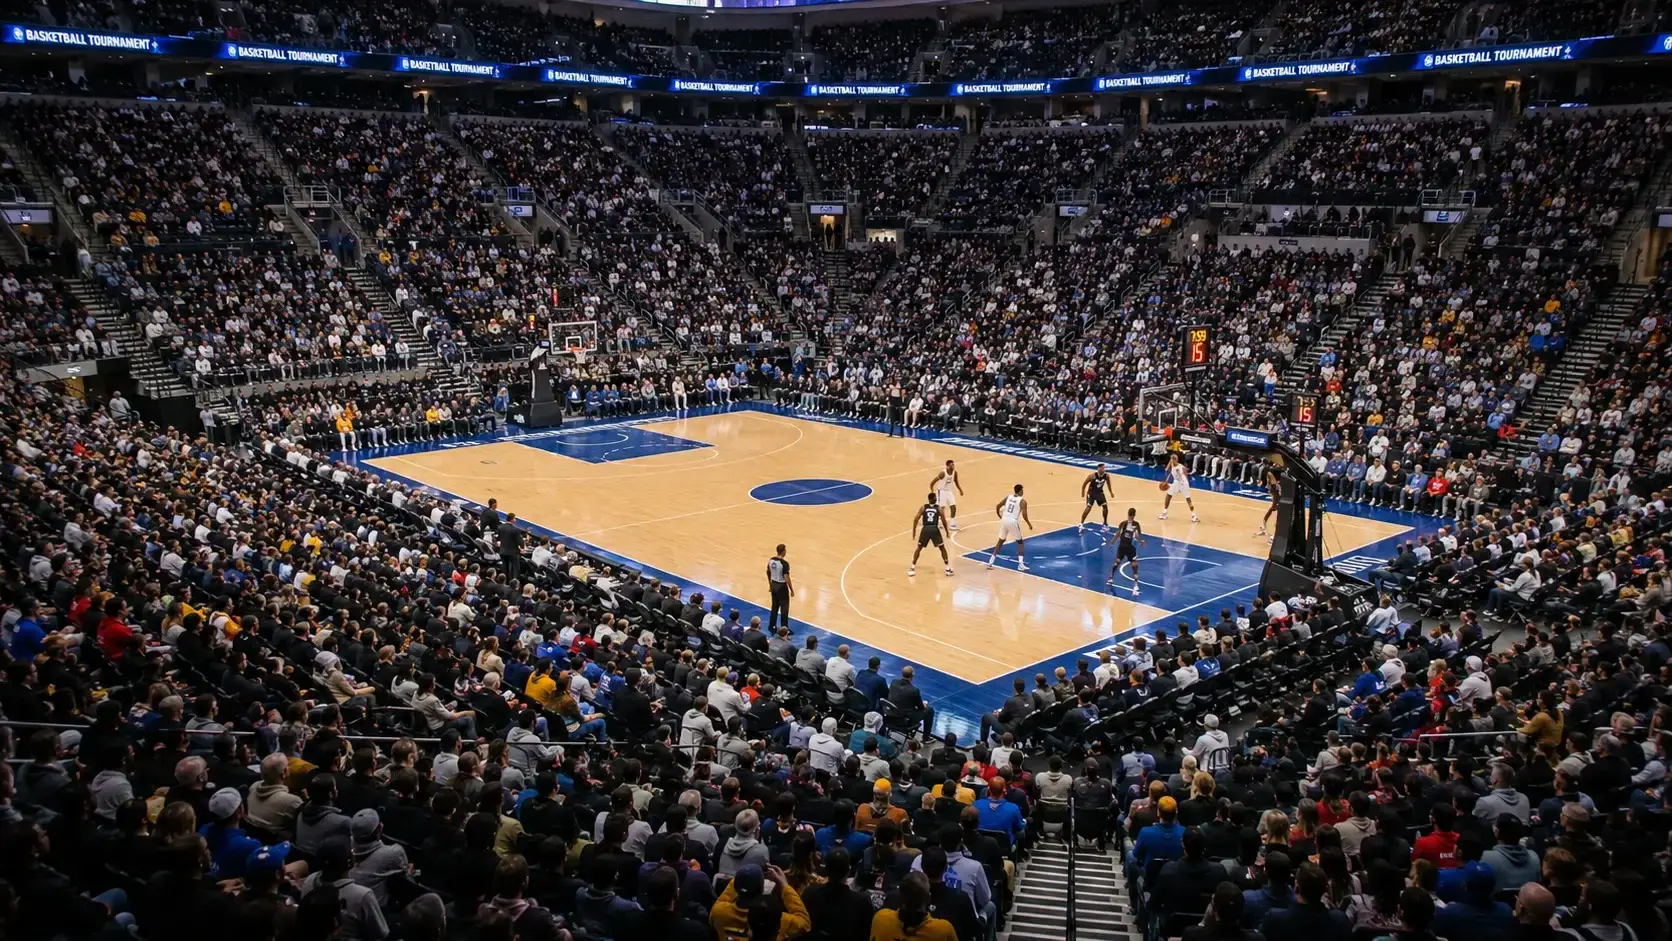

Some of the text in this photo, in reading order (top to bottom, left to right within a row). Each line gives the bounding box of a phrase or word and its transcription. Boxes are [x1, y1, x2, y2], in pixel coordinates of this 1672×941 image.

[26, 29, 150, 50] BASKETBALL TOURNAMENT
[238, 47, 338, 63] BASKETBALL TOURNAMENT
[1435, 45, 1563, 65] BASKETBALL TOURNAMENT
[410, 60, 493, 75] BASKETBALL TOURNAMENT
[1253, 62, 1350, 78] BASKETBALL TOURNAMENT
[555, 71, 627, 85] BASKETBALL TOURNAMENT
[1106, 74, 1185, 87] BASKETBALL TOURNAMENT
[681, 81, 753, 92] BASKETBALL TOURNAMENT
[819, 86, 899, 94] BASKETBALL TOURNAMENT
[964, 83, 1045, 93] BASKETBALL TOURNAMENT
[1192, 342, 1203, 362] 15
[1299, 407, 1311, 422] 15
